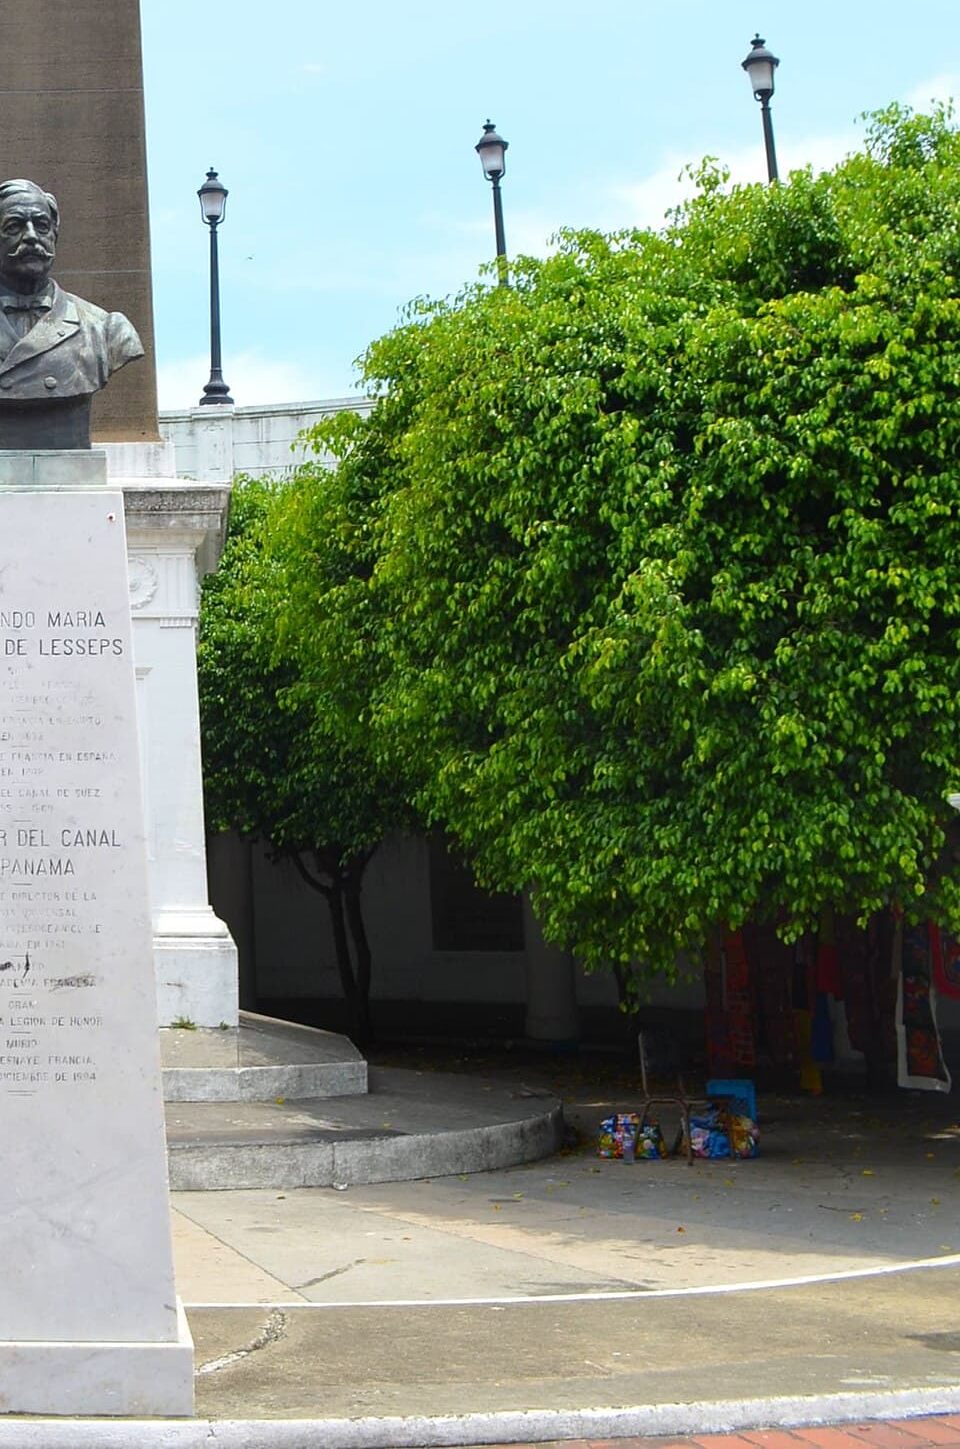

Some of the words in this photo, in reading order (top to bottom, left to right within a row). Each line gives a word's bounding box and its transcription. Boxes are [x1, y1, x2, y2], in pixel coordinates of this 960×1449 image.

[47, 610, 106, 628] MARIA
[4, 638, 28, 656] DE
[39, 638, 123, 656] LESSEPS
[75, 788, 101, 798] SUEZ
[17, 829, 50, 847] DEL
[61, 829, 122, 847] CANAL
[1, 858, 75, 876] PANAMA
[83, 891, 97, 902] LA
[51, 1016, 65, 1026] DE
[55, 1072, 68, 1082] DE
